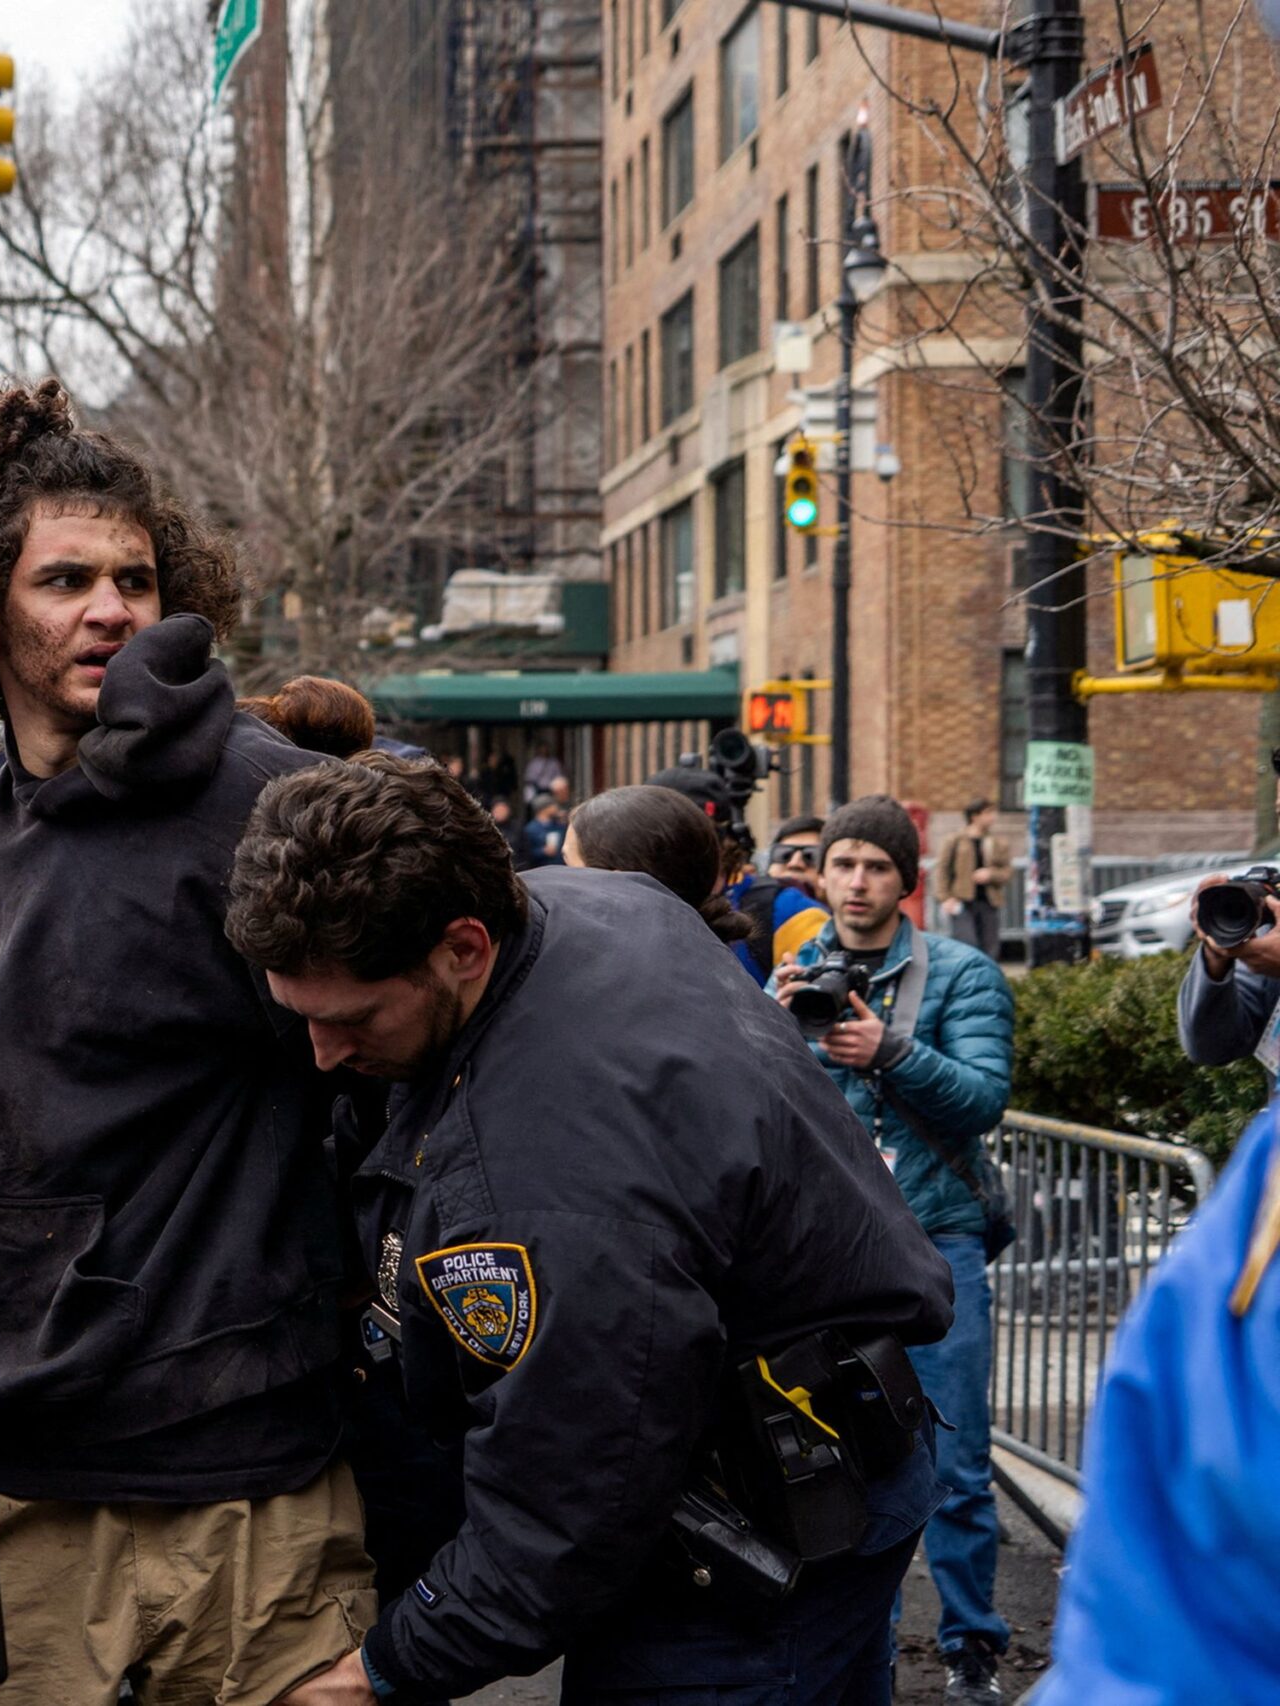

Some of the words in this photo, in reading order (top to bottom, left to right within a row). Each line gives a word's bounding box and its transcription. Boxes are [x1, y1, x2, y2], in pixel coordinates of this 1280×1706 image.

[1131, 196, 1150, 238] E
[1168, 196, 1212, 238] 86
[1229, 195, 1266, 238] St
[1056, 749, 1080, 761] NO
[431, 1267, 519, 1291] DEPARTMENT
[443, 1252, 496, 1274] POLICE
[443, 1307, 468, 1336] CITY
[467, 1339, 487, 1355] OF
[507, 1333, 524, 1357] NEW
[516, 1289, 530, 1329] YORK
